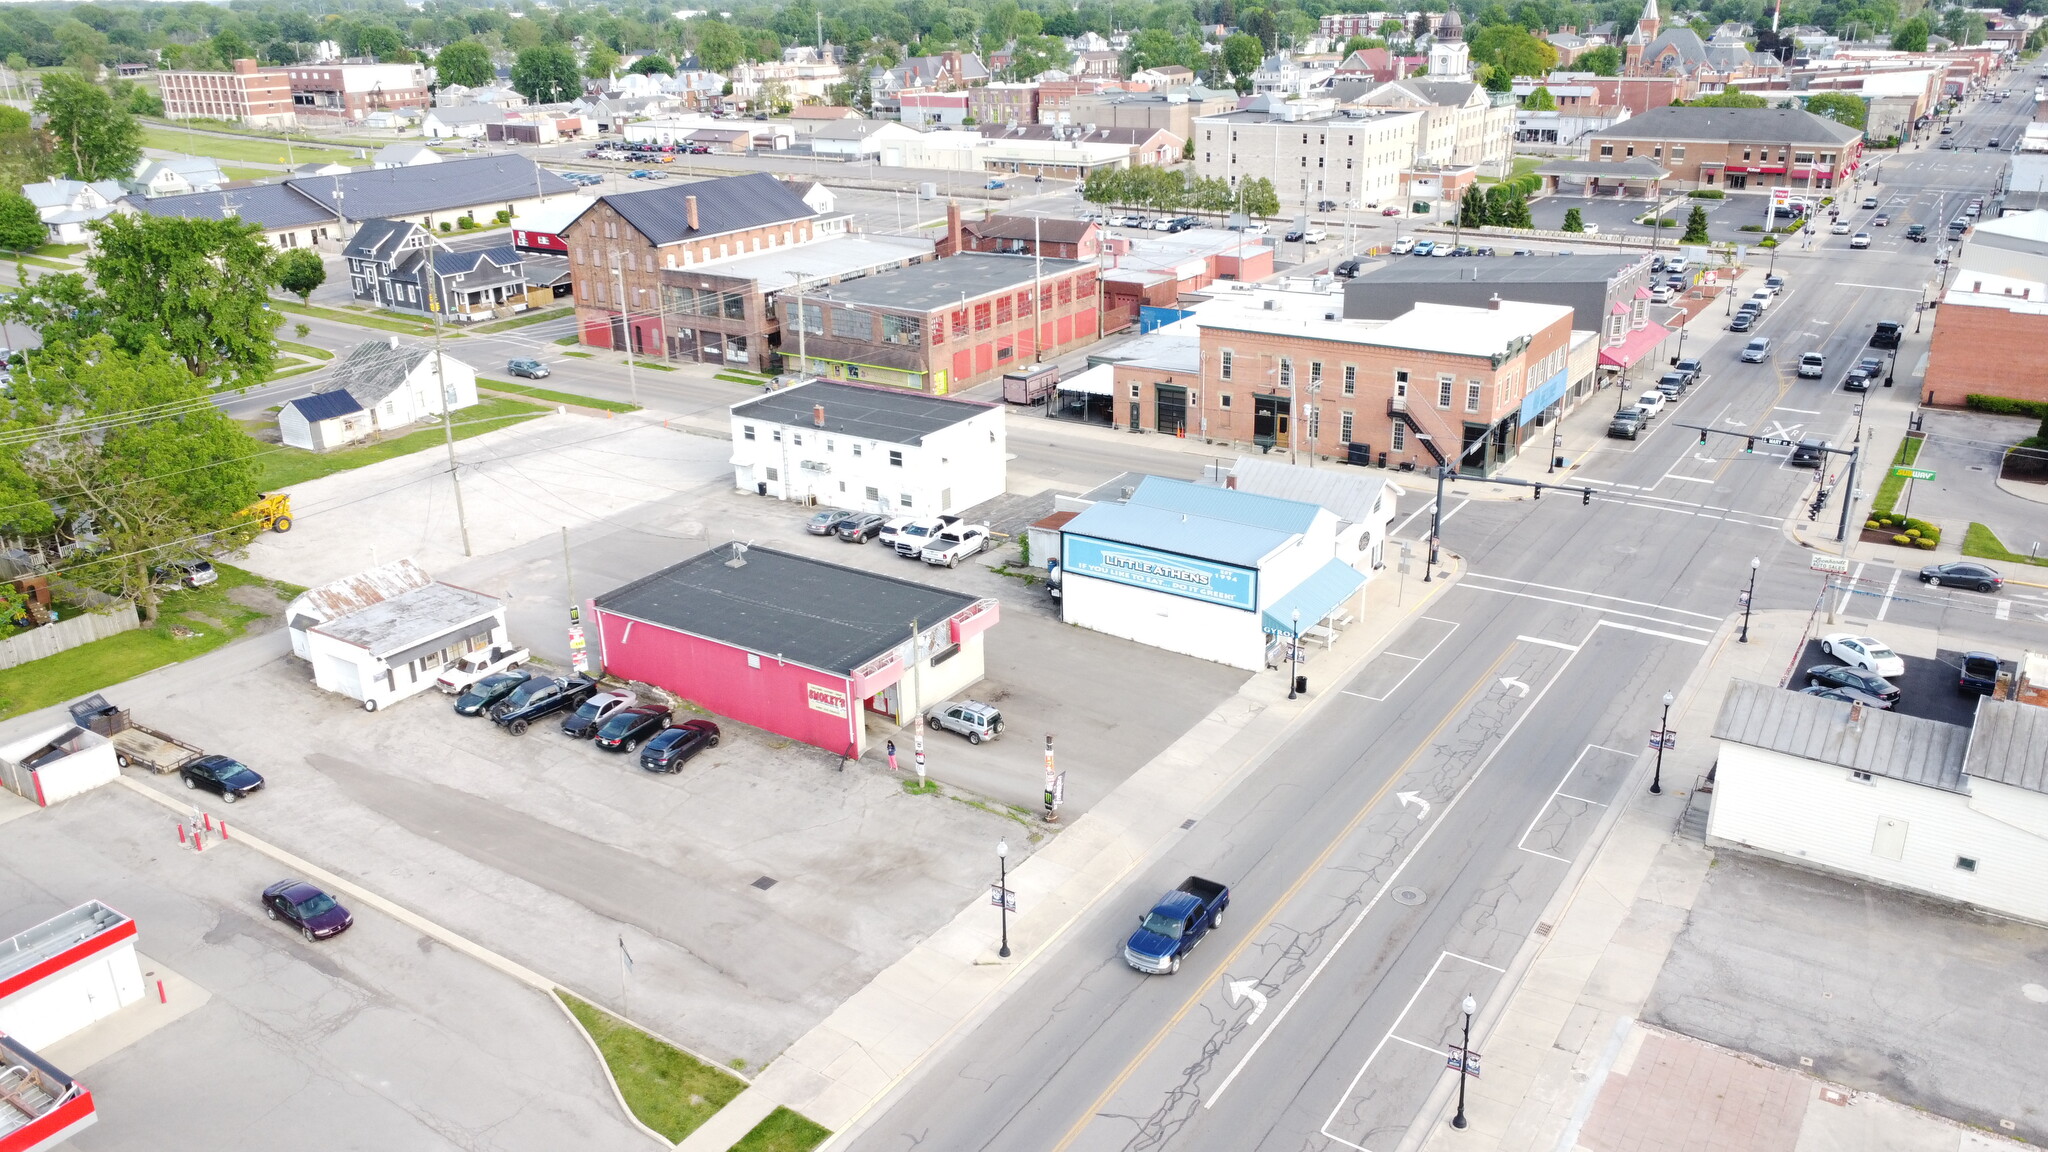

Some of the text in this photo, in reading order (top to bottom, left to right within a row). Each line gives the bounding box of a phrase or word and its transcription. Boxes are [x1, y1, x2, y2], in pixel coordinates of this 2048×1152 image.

[1896, 469, 1934, 480] SUBWAY
[1089, 564, 1108, 574] YOU
[1110, 569, 1130, 578] LIKE
[1131, 573, 1144, 581] TO
[1172, 582, 1187, 591] DO
[1105, 555, 1209, 585] LITTLE ATHENS
